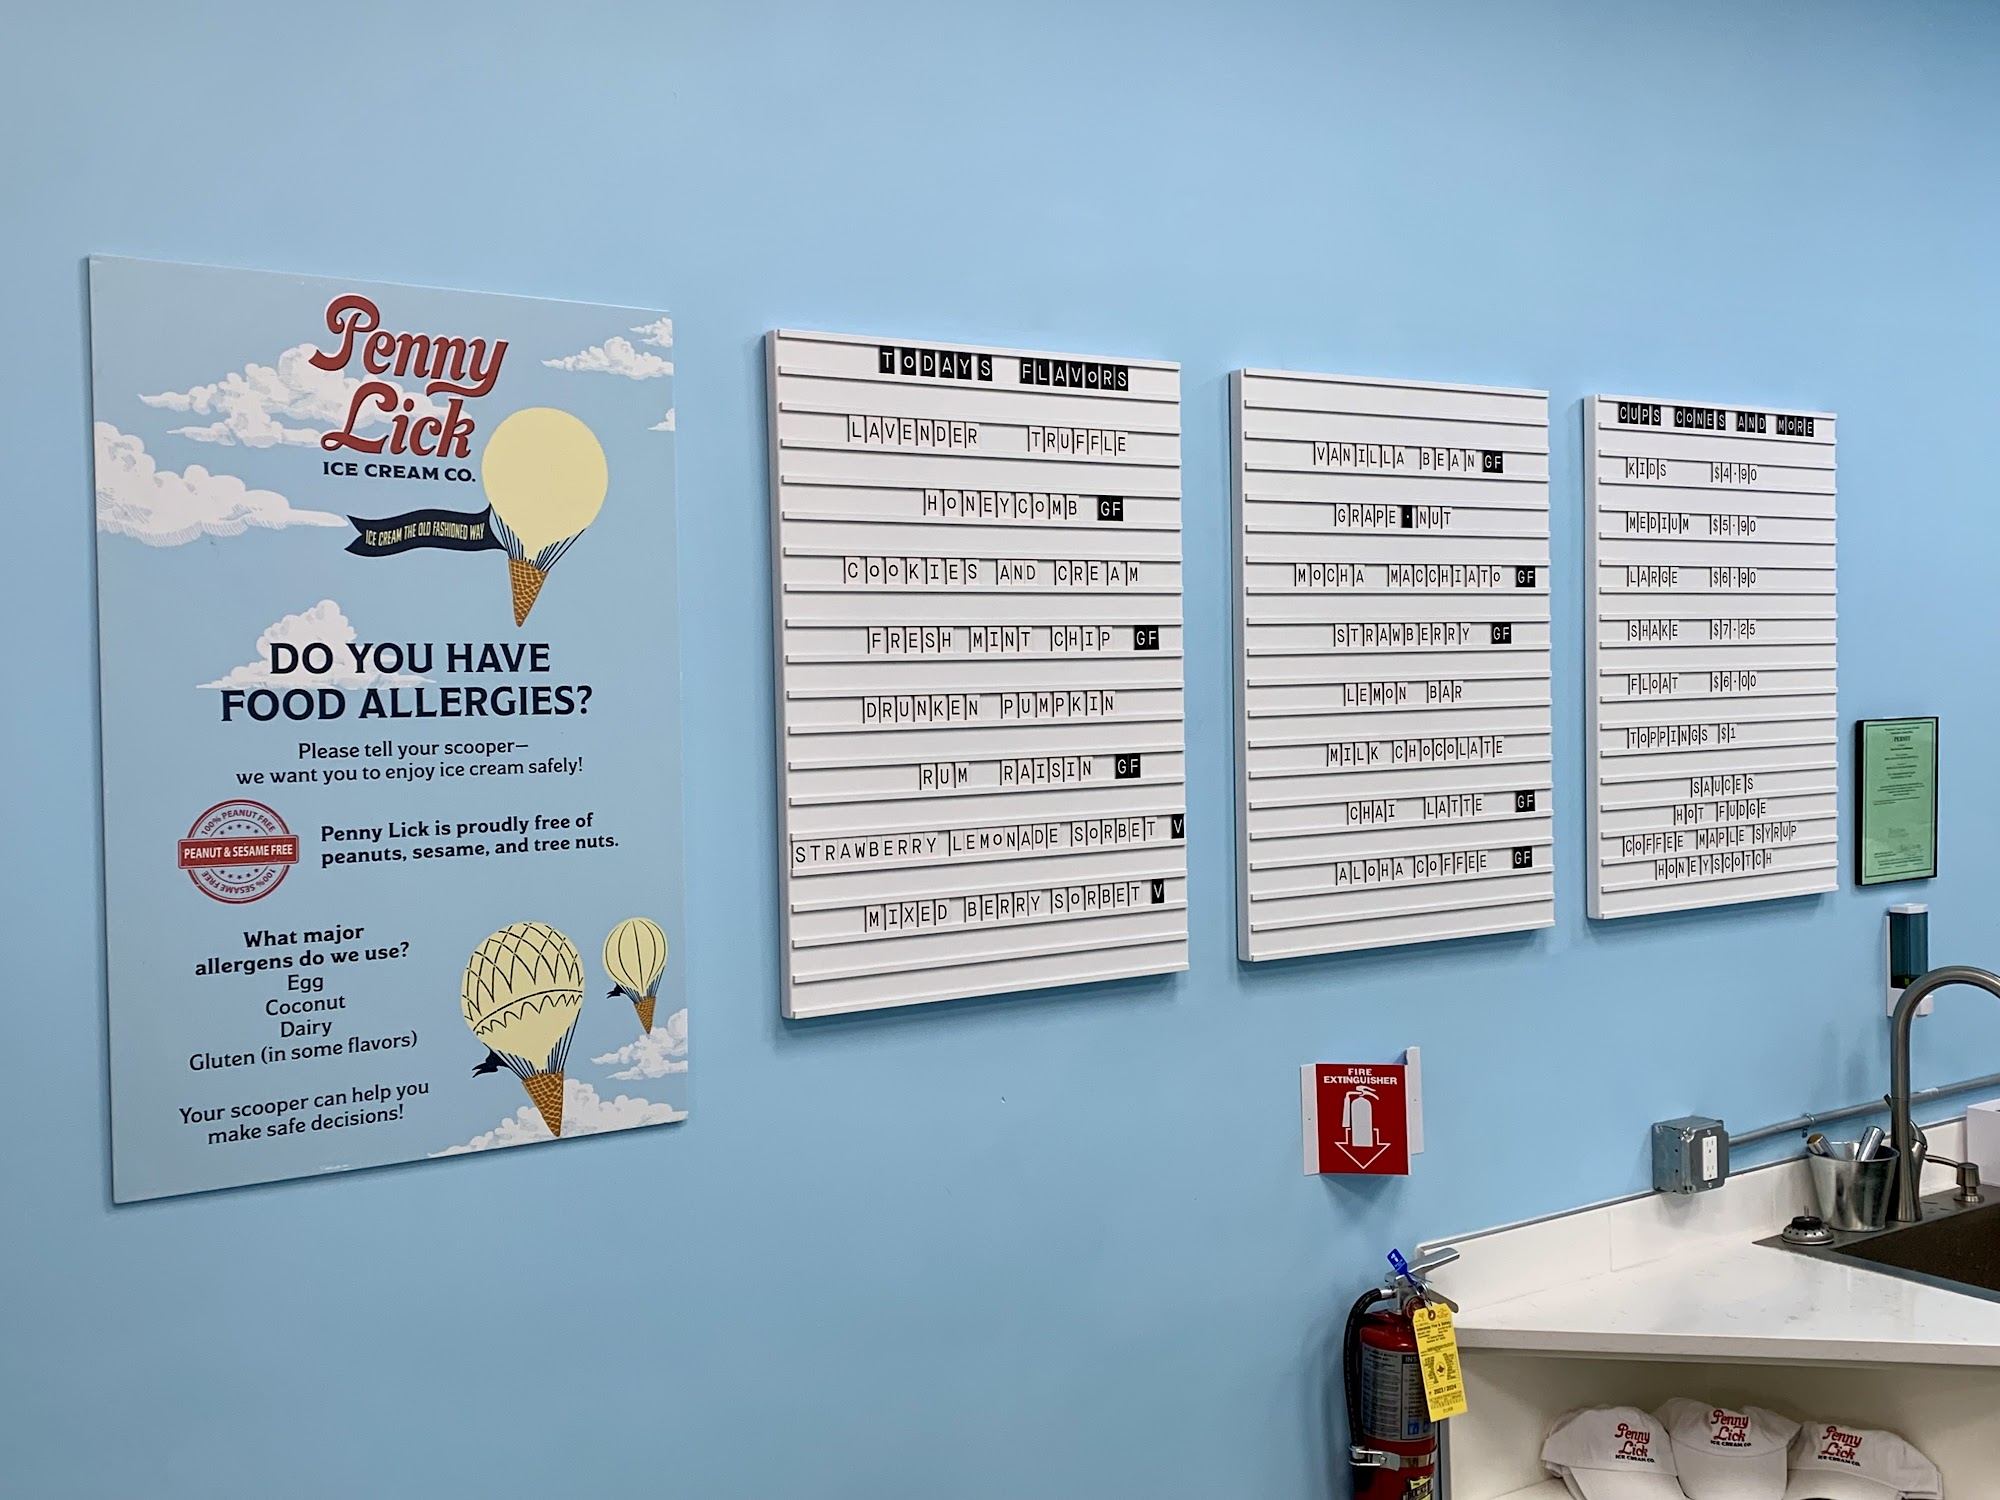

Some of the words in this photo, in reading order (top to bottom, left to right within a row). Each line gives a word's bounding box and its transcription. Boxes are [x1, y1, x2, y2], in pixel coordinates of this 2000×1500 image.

[308, 293, 510, 397] Penny
[320, 381, 476, 459] Lick
[1620, 406, 1661, 423] CUPS
[1738, 416, 1765, 430] AND
[852, 421, 978, 444] LAVENDER
[1032, 431, 1127, 452] TRUFFLE
[1317, 446, 1405, 466] VANILLA
[1423, 452, 1475, 468] BEAN
[1485, 457, 1502, 470] GF
[323, 461, 358, 477] ICE
[364, 463, 439, 481] CREAM
[444, 467, 477, 483] CO.
[1629, 462, 1667, 477] KIDS
[1100, 501, 1121, 517] GF
[1338, 508, 1396, 525] GRAPE
[1420, 510, 1452, 526] NUT
[365, 529, 377, 546] ICE
[378, 527, 403, 546] CREAM
[404, 523, 417, 540] THE
[418, 521, 431, 536] OLD
[432, 521, 468, 540] FASHIONED
[469, 522, 485, 540] WAY
[1630, 516, 1689, 531] MEDIUM
[1000, 564, 1036, 581] AND
[1058, 564, 1139, 582] CREAM
[1517, 571, 1534, 584] GF
[1630, 571, 1678, 584] LARGE
[871, 631, 952, 649] FRESH
[973, 631, 1031, 648] MINT
[1054, 631, 1111, 647] CHIP
[1136, 630, 1158, 646] GF
[1337, 625, 1470, 643] STRAWBERRY
[1493, 627, 1510, 641] GF
[1631, 624, 1679, 638] SHAKE
[270, 642, 334, 675] DO
[347, 642, 434, 673] YOU
[446, 642, 550, 673] HAVE
[1430, 685, 1463, 699] BAR
[221, 688, 346, 722] FOOD
[359, 685, 592, 718] ALLERGIES?
[867, 699, 978, 719] DRUNKEN
[1004, 696, 1114, 715] PUMPKIN
[1721, 727, 1736, 741] $1
[299, 742, 359, 760] Please
[364, 741, 393, 758] tell
[397, 743, 439, 760] your
[1330, 745, 1379, 762] MILK
[236, 772, 265, 785] we
[270, 768, 318, 783] want
[323, 769, 357, 786] you
[362, 767, 381, 780] to
[385, 763, 435, 782] enjoy
[439, 763, 465, 777] ice
[469, 763, 524, 776] cream
[528, 756, 583, 776] safely!
[924, 767, 968, 785] RUM
[1004, 760, 1092, 781] RAISIN
[1117, 759, 1139, 774] GF
[1693, 777, 1754, 795] SAUCES
[1350, 804, 1396, 821] CHAI
[1427, 798, 1483, 816] LATTE
[1517, 795, 1534, 808] GF
[1719, 802, 1767, 818] FUDGE
[201, 816, 222, 835] 100%
[222, 809, 258, 820] PEANUT
[257, 815, 277, 833] FREE
[321, 825, 383, 843] Penny
[388, 821, 430, 839] Lick
[435, 820, 451, 836] is
[456, 816, 529, 838] proudly
[534, 815, 570, 830] free
[575, 813, 593, 828] of
[796, 837, 937, 863] STRAWBERRY
[1173, 819, 1183, 834] V
[1699, 829, 1745, 846] MAPLE
[1755, 825, 1797, 841] SYRUP
[184, 847, 222, 859] PEANUT
[224, 846, 231, 857] &
[232, 845, 269, 857] SESAME
[271, 844, 293, 855] FREE
[321, 847, 407, 869] peanuts,
[412, 844, 490, 860] sesame,
[495, 838, 529, 854] and
[533, 839, 569, 852] tree
[575, 835, 619, 849] nuts.
[1514, 851, 1531, 864] GF
[201, 870, 220, 888] FREE
[255, 869, 277, 887] 100%
[220, 883, 256, 894] SESAME
[869, 904, 948, 926] MIXED
[968, 896, 1040, 918] BERRY
[1153, 883, 1162, 899] V
[243, 929, 298, 948] What
[303, 924, 364, 945] major
[195, 956, 294, 977] allergens
[299, 949, 325, 967] do
[330, 950, 359, 964] we
[364, 942, 409, 961] use?
[287, 973, 324, 994] Egg
[265, 995, 346, 1016] Coconut
[280, 1019, 332, 1038] Dairy
[189, 1052, 255, 1071] Gluten
[260, 1045, 287, 1065] (in
[293, 1043, 343, 1060] some
[348, 1031, 418, 1054] flavors)
[1323, 1076, 1398, 1085] EXTINGUISHER
[1348, 1068, 1373, 1076] FIRE
[178, 1106, 226, 1125] Your
[230, 1097, 309, 1121] scooper
[313, 1093, 347, 1107] can
[352, 1084, 392, 1104] help
[396, 1082, 429, 1100] you
[208, 1124, 262, 1145] make
[267, 1116, 306, 1137] safe
[310, 1105, 404, 1131] decisions!
[1710, 1409, 1749, 1429] Penny
[1614, 1423, 1650, 1445] Penny
[1713, 1426, 1746, 1442] Lick
[1822, 1425, 1863, 1448] Penny
[1618, 1440, 1648, 1458] Lick
[1821, 1442, 1856, 1460] Lick
